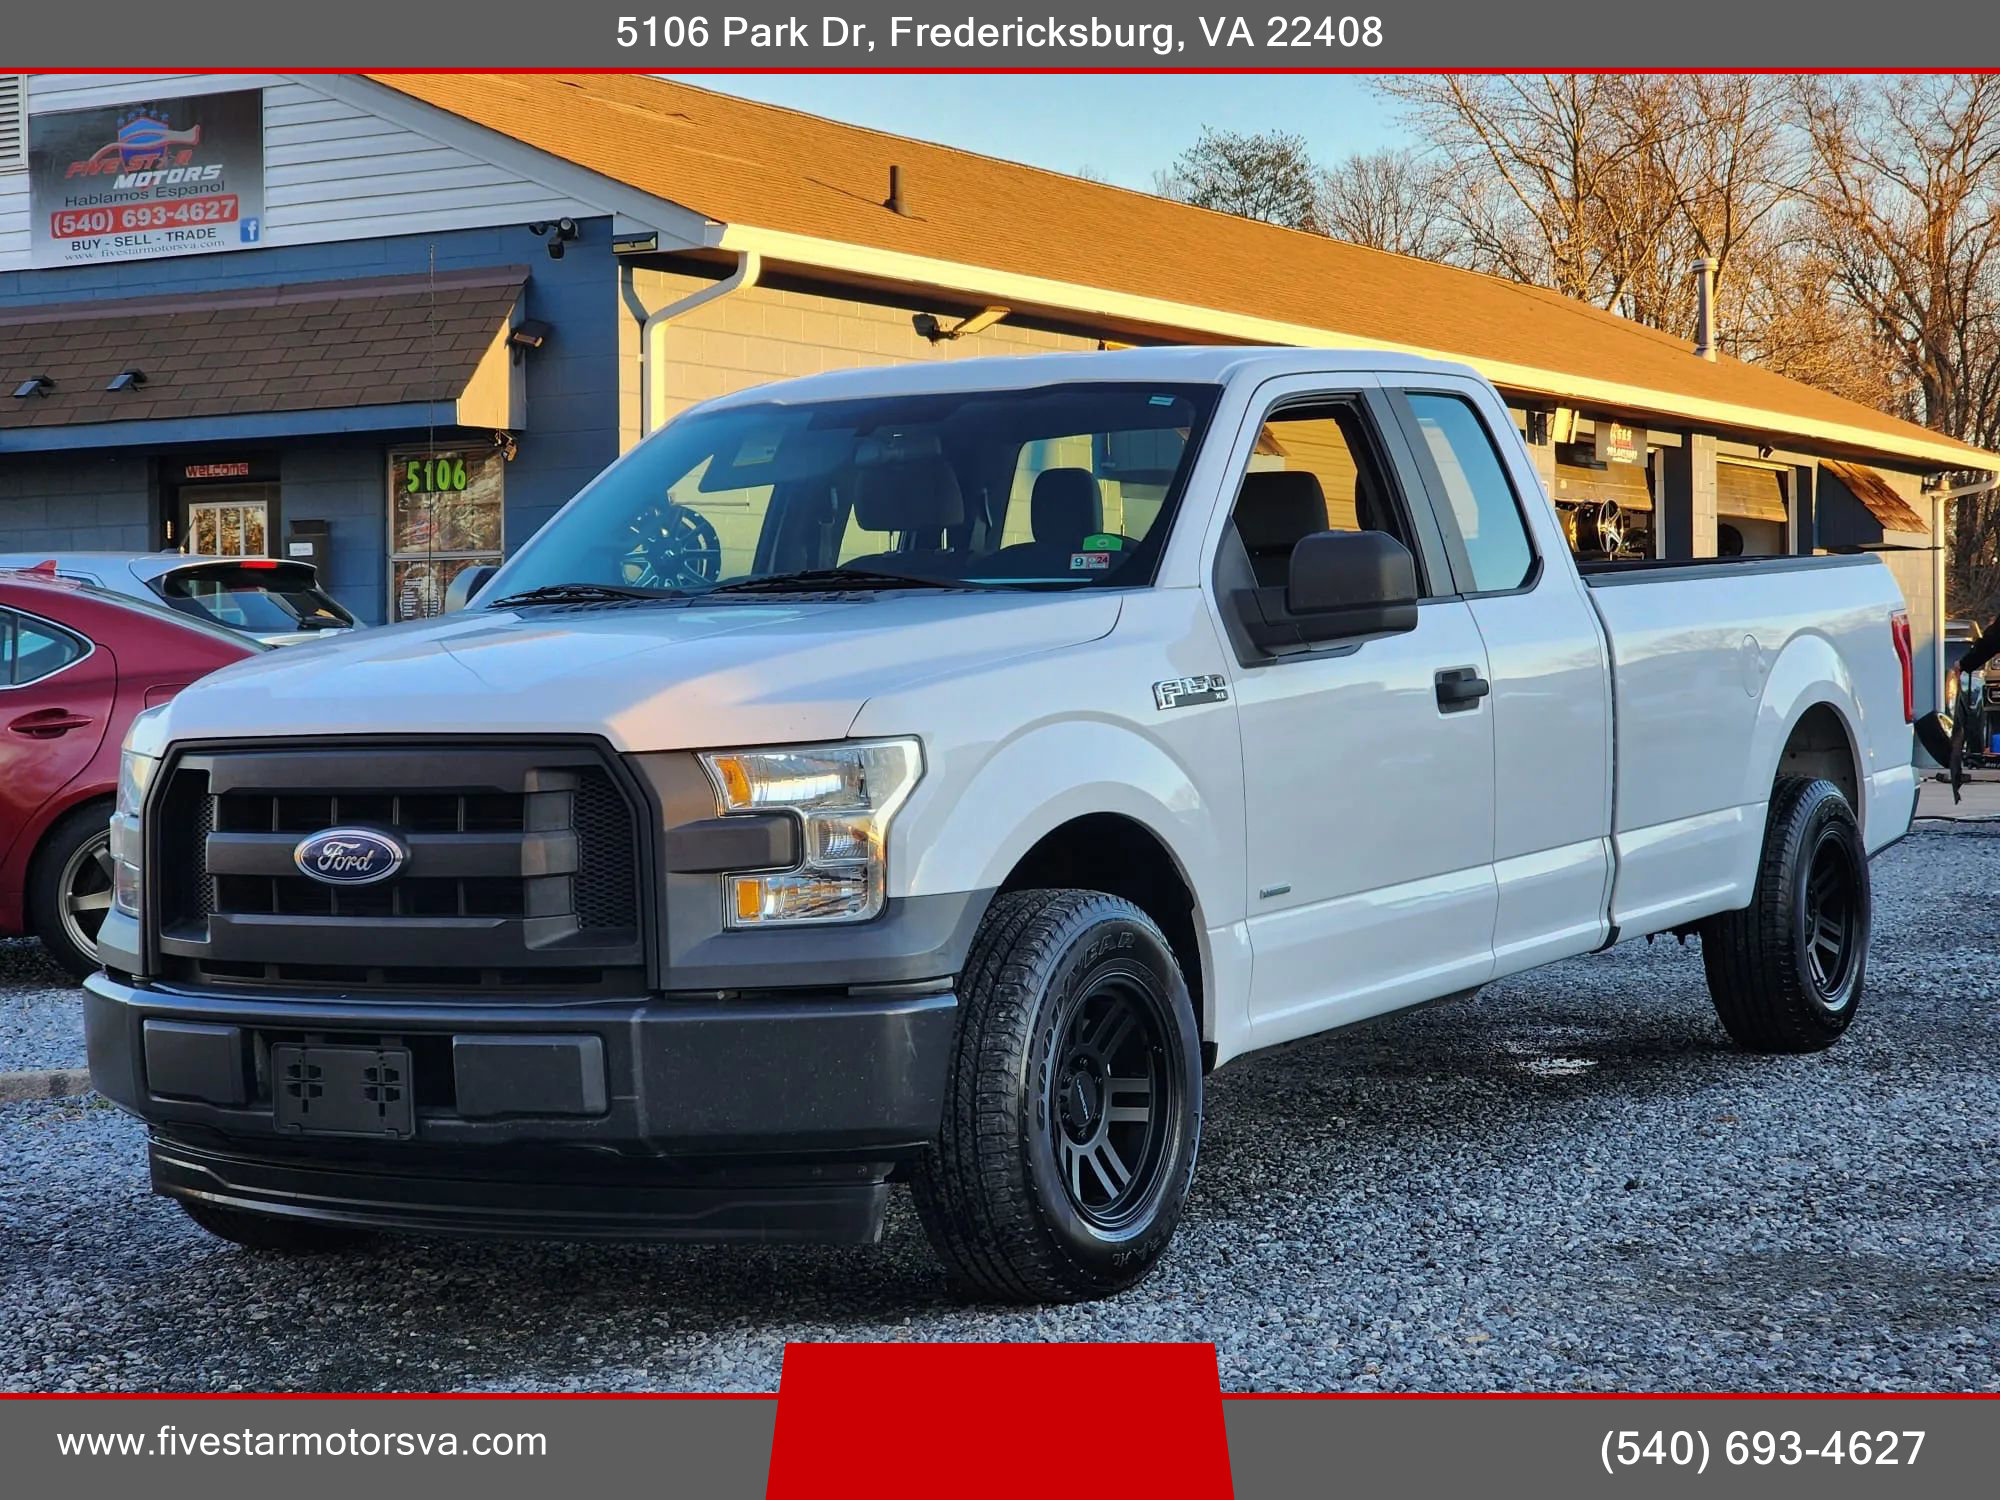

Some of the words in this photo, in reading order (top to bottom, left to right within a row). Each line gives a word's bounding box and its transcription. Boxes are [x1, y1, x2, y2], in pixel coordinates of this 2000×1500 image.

[64, 156, 121, 179] FIVE
[127, 150, 193, 172] STR
[113, 164, 223, 190] MOTORS
[65, 190, 149, 207] Hablamos
[53, 209, 114, 236] (540)
[121, 199, 236, 228] 693-4627
[72, 238, 101, 251] BUY
[114, 233, 152, 248] SELL
[165, 227, 217, 243] TRADE
[407, 459, 467, 493] 5106
[317, 841, 375, 871] Ford
